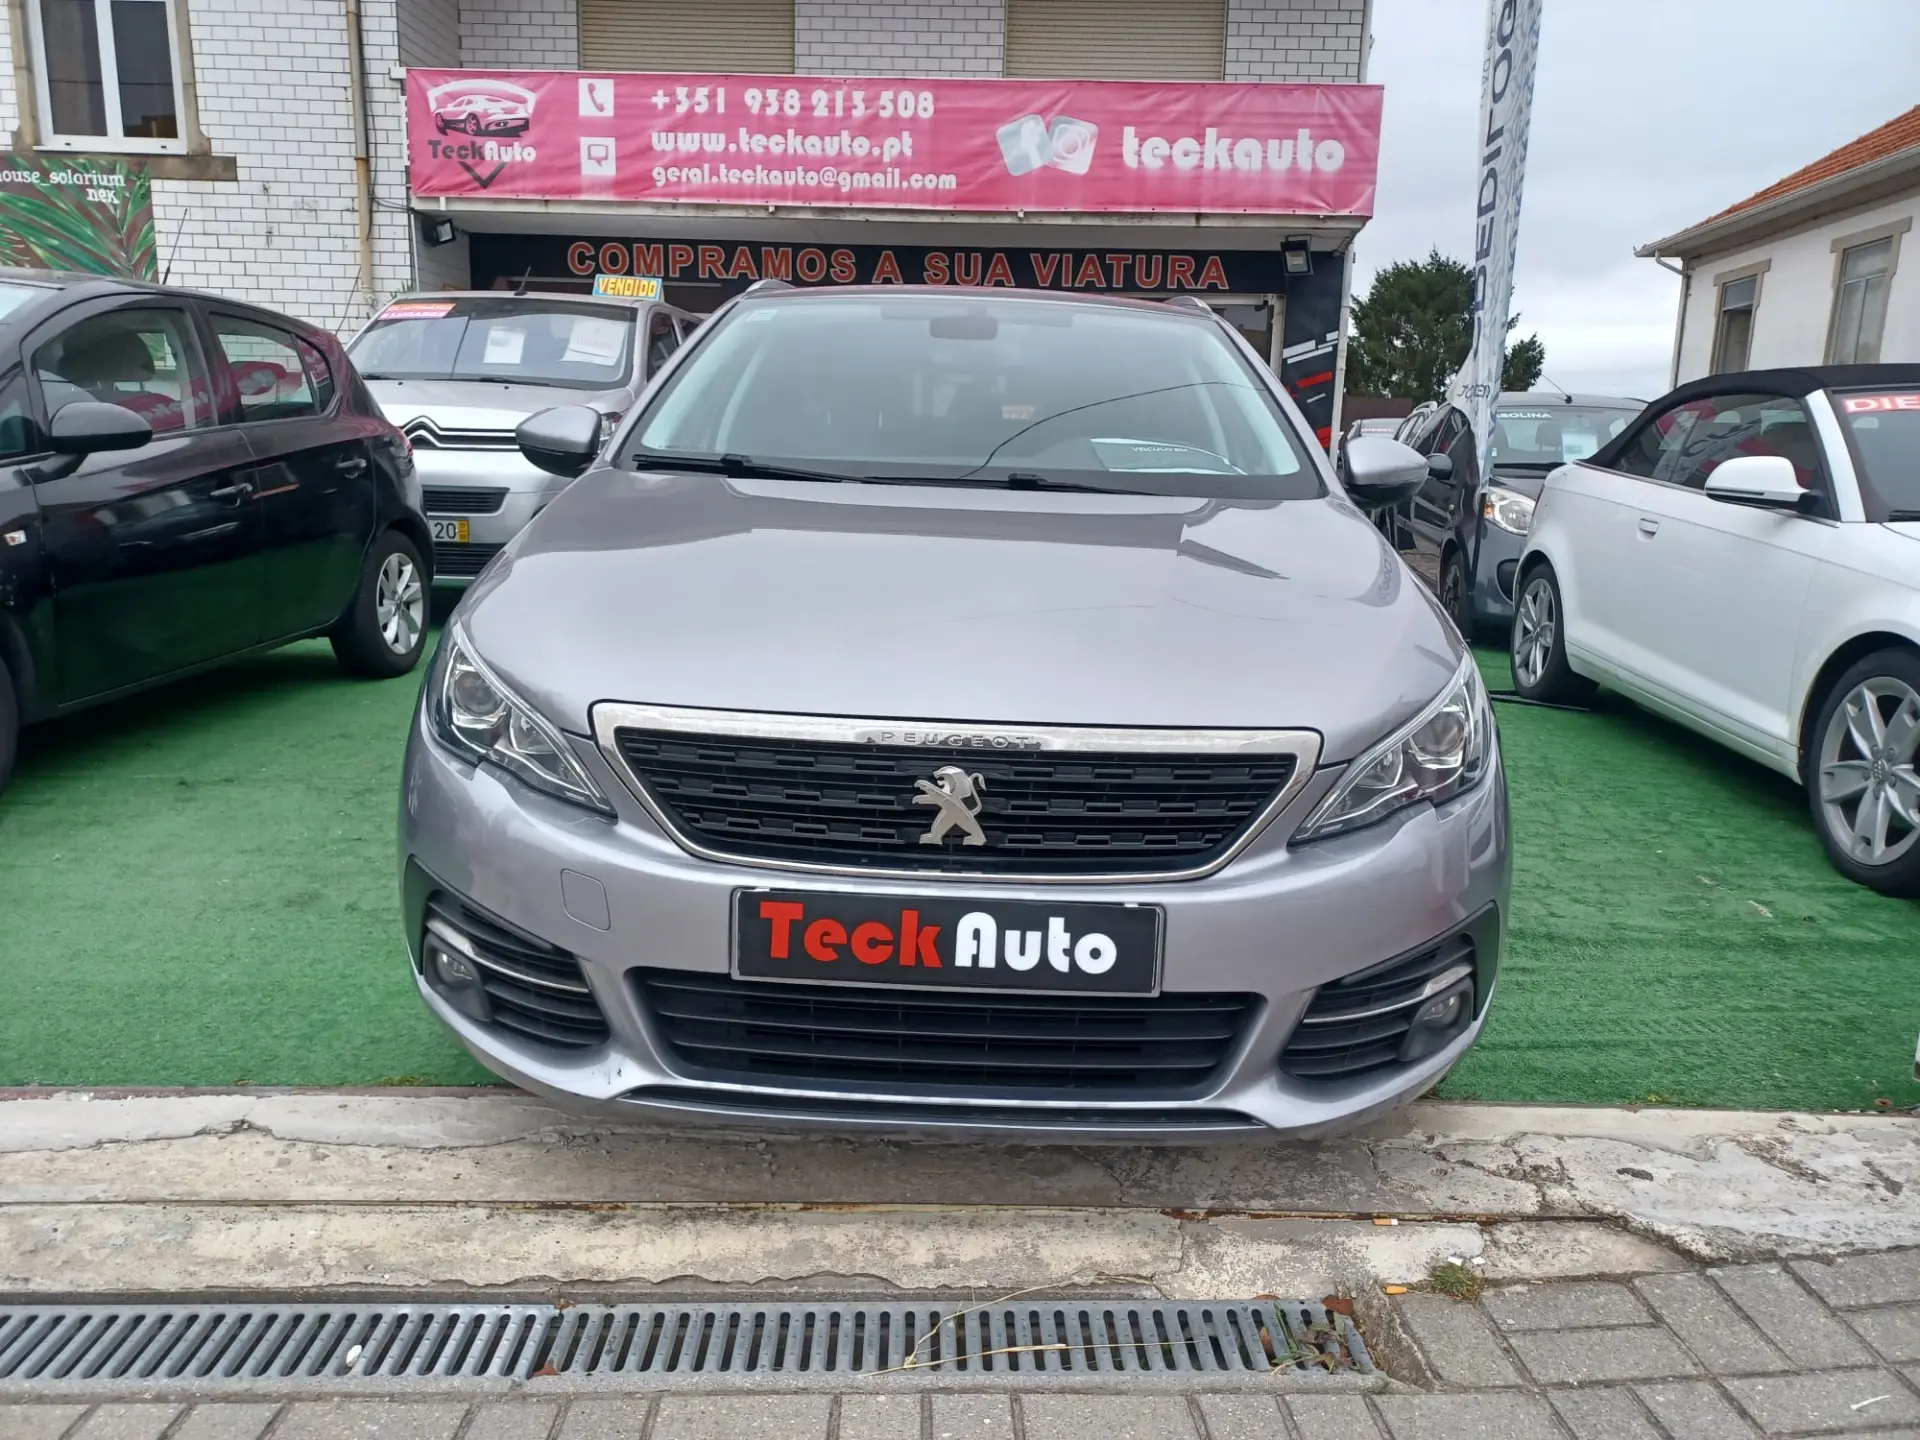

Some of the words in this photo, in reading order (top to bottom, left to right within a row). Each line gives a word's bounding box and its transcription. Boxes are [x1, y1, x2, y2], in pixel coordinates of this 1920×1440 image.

[651, 87, 726, 114] +351
[744, 88, 801, 116] 938
[811, 89, 865, 118] 213
[878, 90, 935, 119] 508
[428, 139, 537, 163] TeckAuto
[651, 127, 913, 162] www.teckauto.pt
[1122, 125, 1346, 173] teckauto
[651, 163, 957, 192] geral.teckauto@gmail.com
[567, 242, 856, 284] COMPRAMOS
[871, 250, 904, 286] A
[923, 251, 1016, 287] SUA
[1030, 253, 1230, 290] VIATURA
[598, 277, 657, 298] VENDIDO
[434, 521, 457, 540] 20
[881, 731, 1029, 749] PEUGEOT
